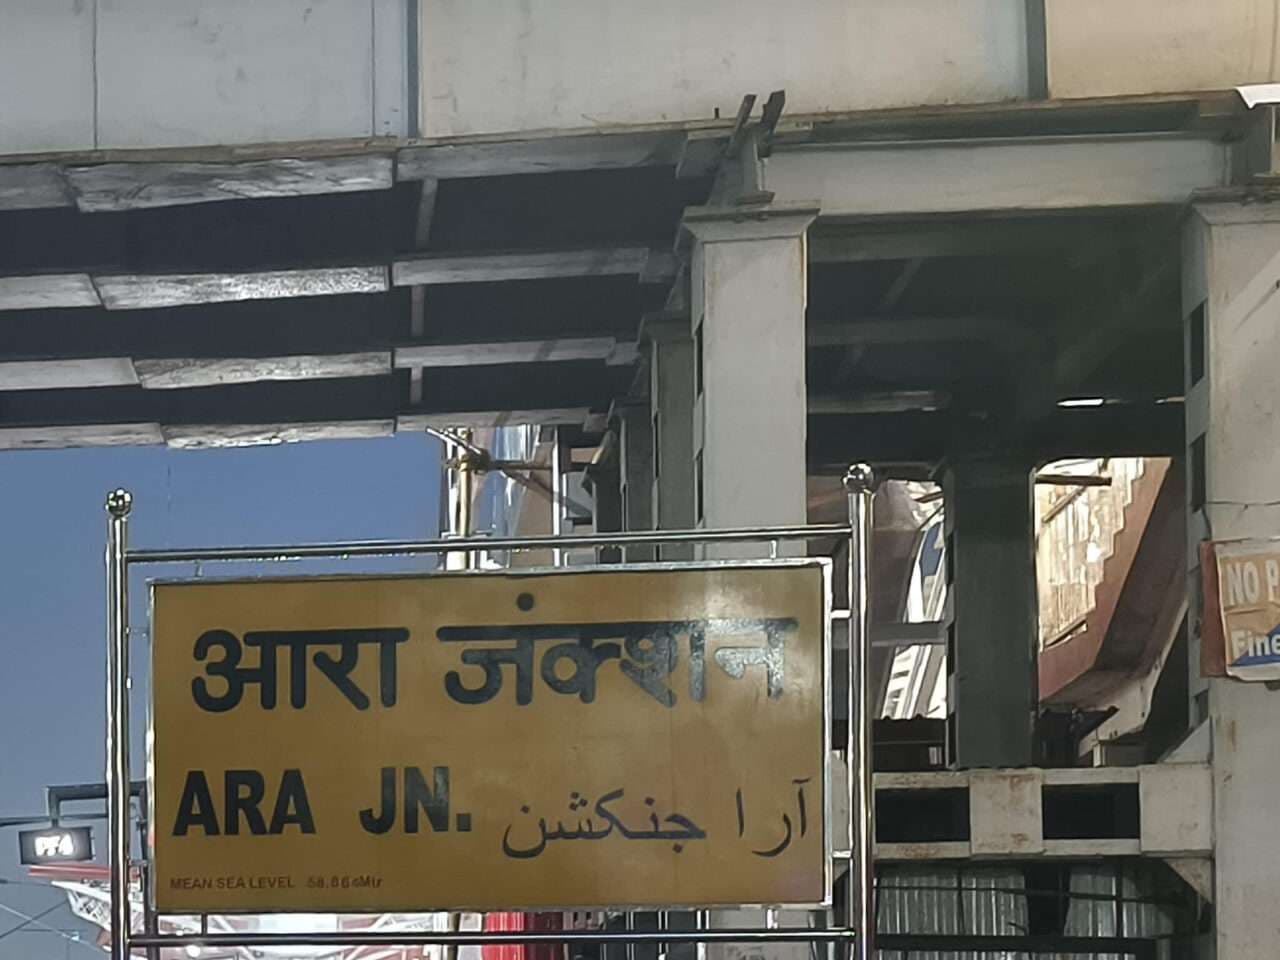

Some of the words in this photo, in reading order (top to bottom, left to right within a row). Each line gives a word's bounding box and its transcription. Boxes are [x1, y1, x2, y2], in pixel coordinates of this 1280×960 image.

[1227, 561, 1259, 605] NO
[191, 629, 409, 712] आरा
[436, 593, 797, 708] जंक्शन
[1232, 630, 1280, 659] Fine
[173, 768, 315, 836] ARA
[359, 766, 472, 833] JN.
[170, 877, 213, 889] MEAN
[215, 877, 247, 889] SEA
[249, 876, 295, 889] LEVEL
